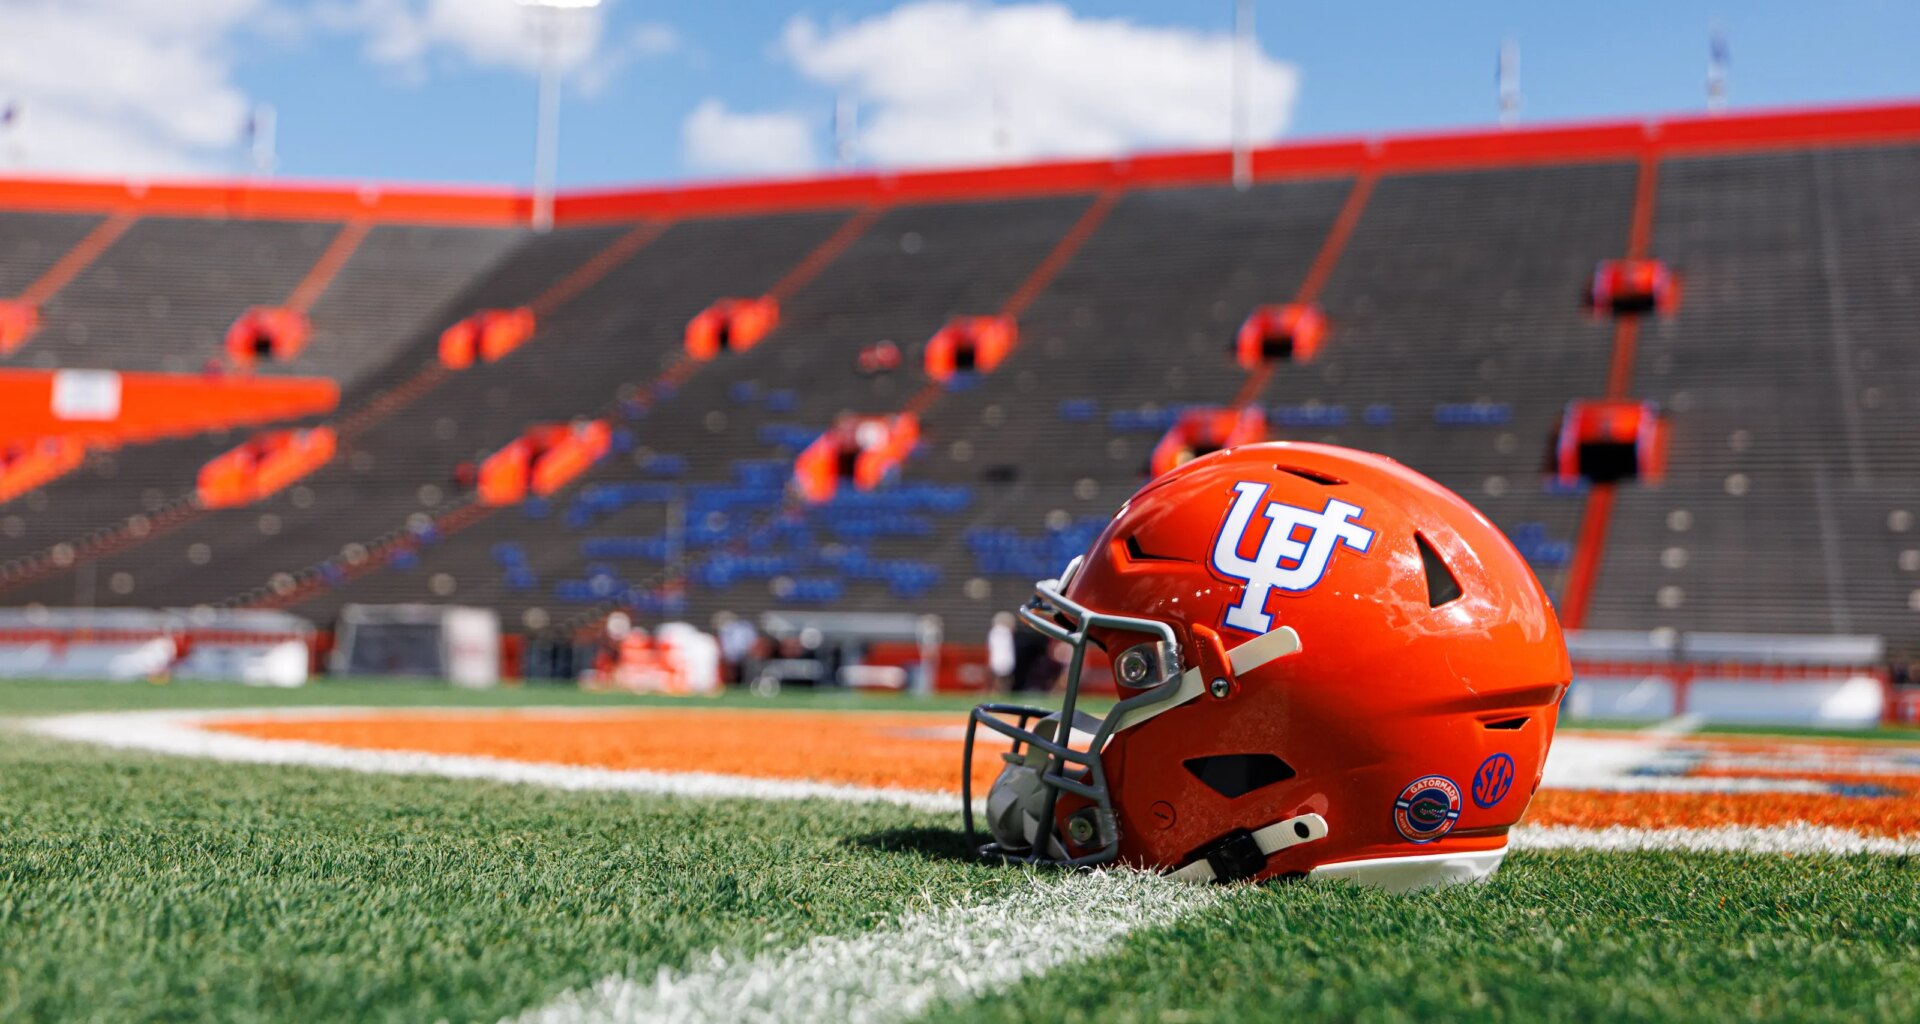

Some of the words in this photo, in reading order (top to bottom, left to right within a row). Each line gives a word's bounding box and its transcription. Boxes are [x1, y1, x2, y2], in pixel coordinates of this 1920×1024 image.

[1210, 480, 1376, 635] UF
[1410, 779, 1458, 803] GATORMADE
[1475, 756, 1513, 804] SEC
